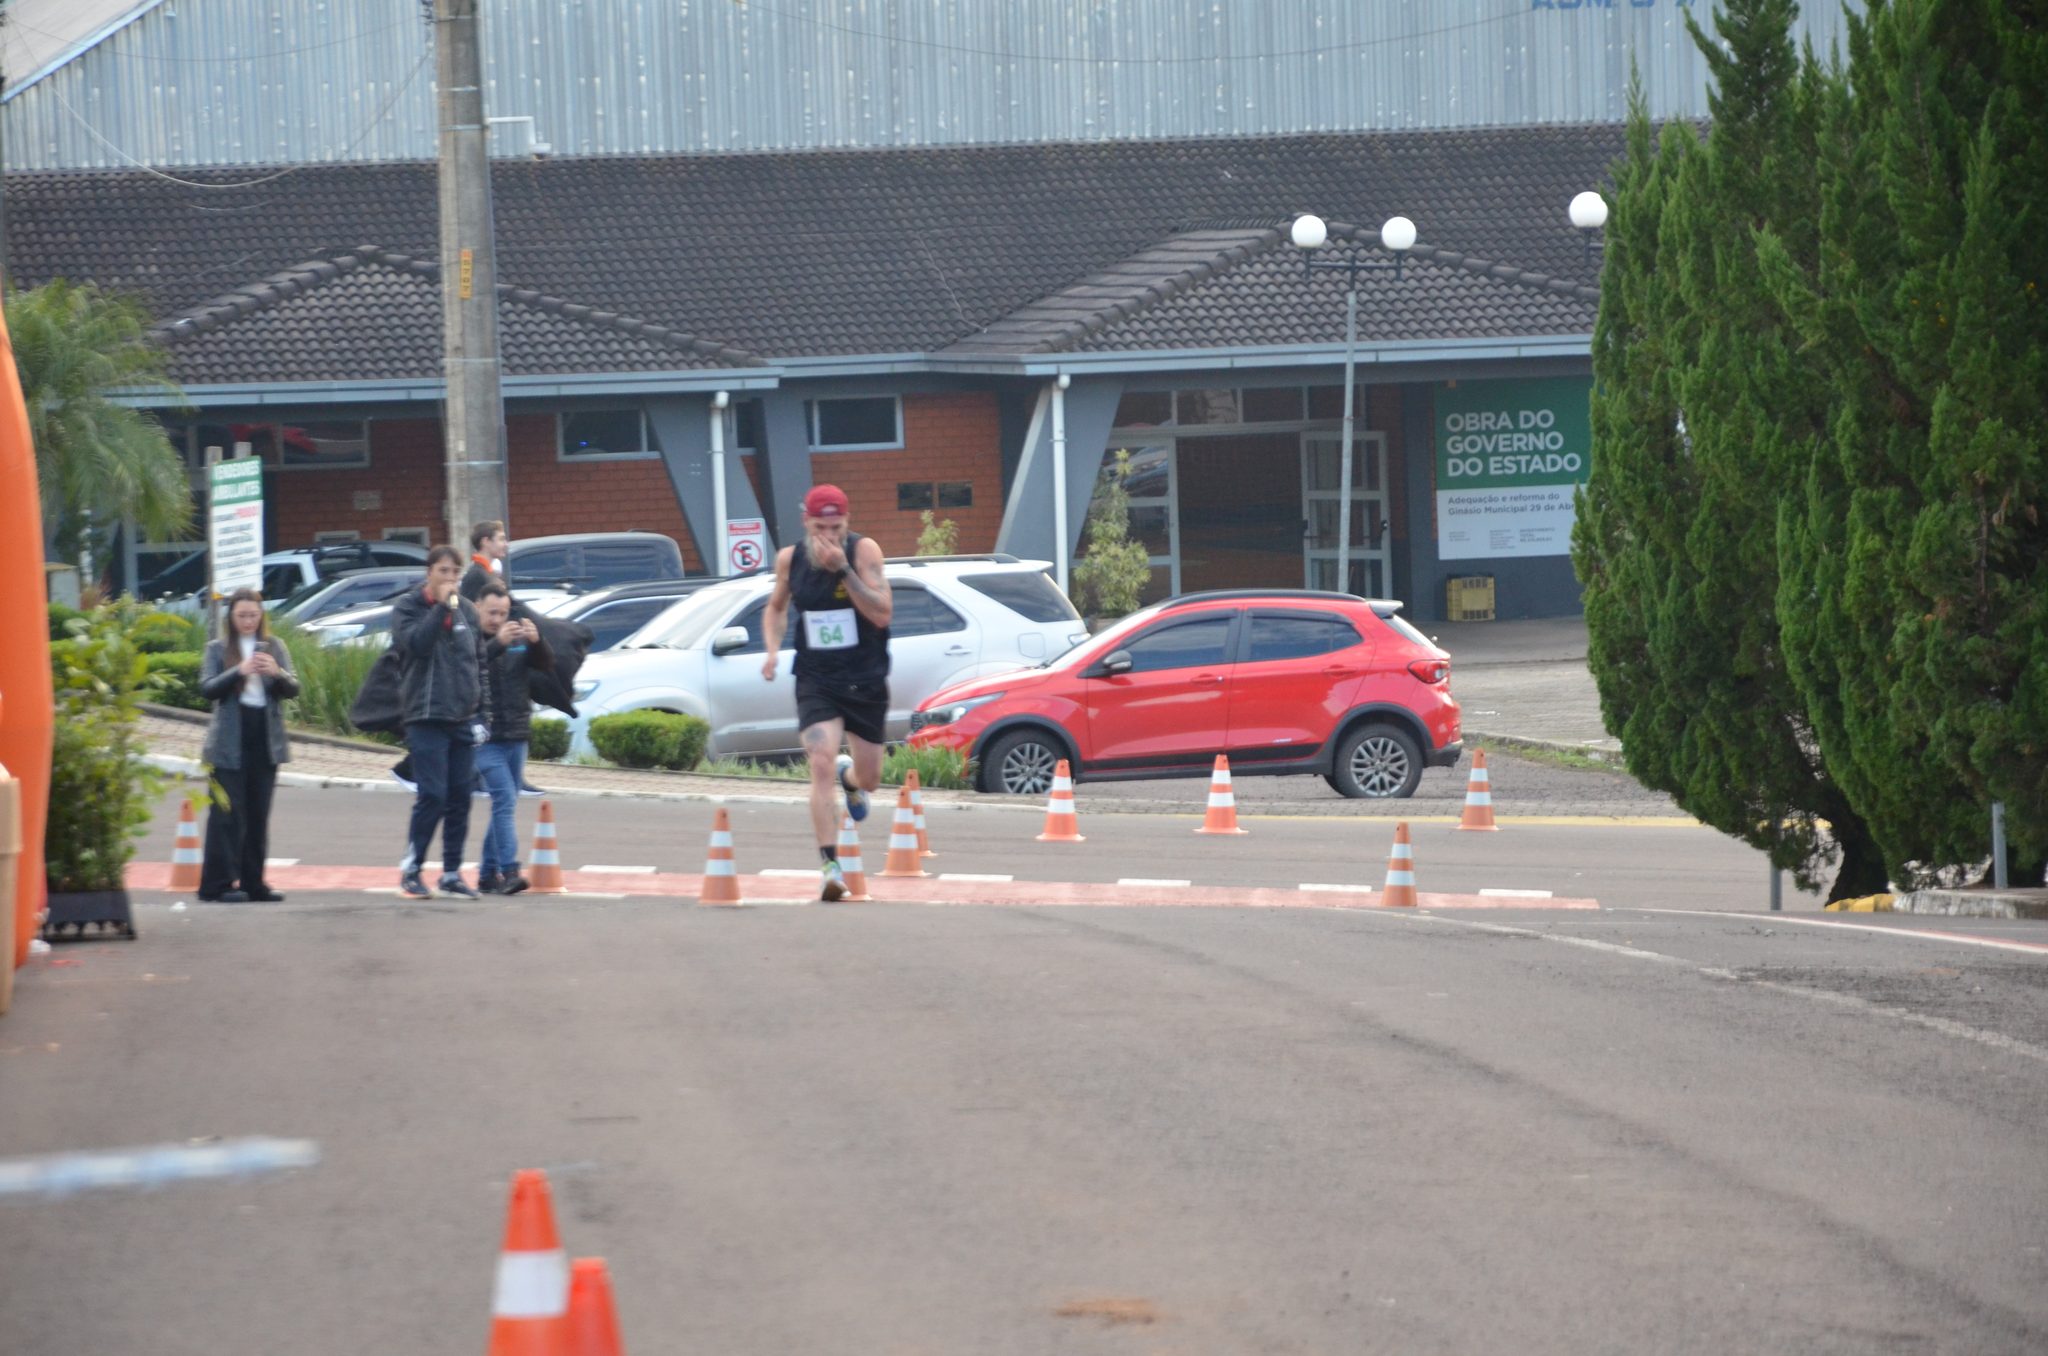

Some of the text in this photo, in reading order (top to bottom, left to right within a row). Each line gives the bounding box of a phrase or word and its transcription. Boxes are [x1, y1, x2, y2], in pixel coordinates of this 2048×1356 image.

[1445, 409, 1555, 432] OBRA DO
[1446, 431, 1564, 454] GOVERNO
[1447, 453, 1582, 477] DO ESTADO
[1448, 494, 1499, 506] Adequação
[1510, 493, 1546, 502] reforma
[1548, 492, 1560, 501] do
[1448, 505, 1482, 515] Ginásio
[1484, 504, 1527, 514] Municipal
[1529, 503, 1541, 512] 29
[1544, 503, 1555, 511] de
[819, 624, 844, 645] 64
